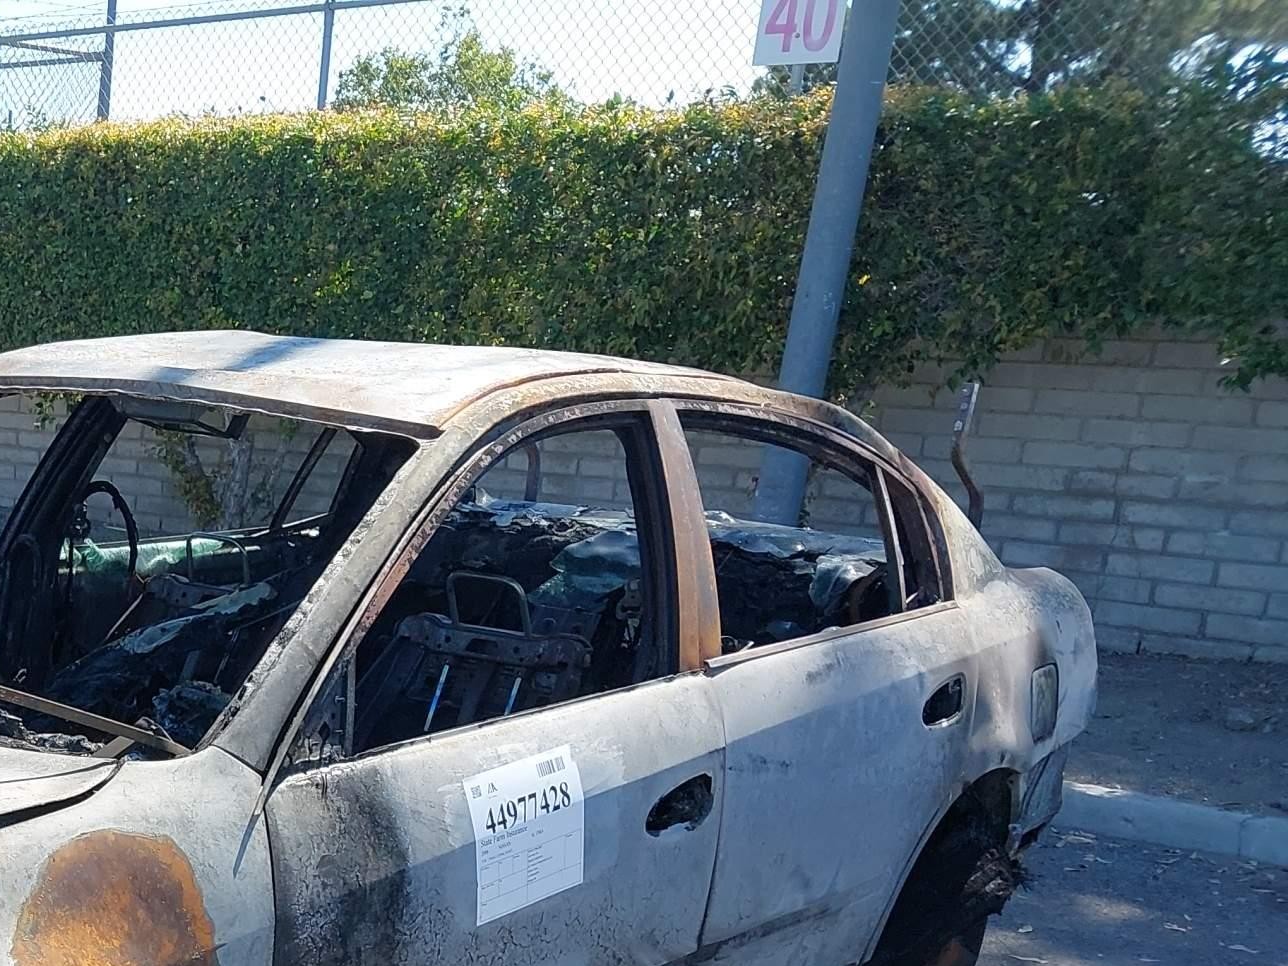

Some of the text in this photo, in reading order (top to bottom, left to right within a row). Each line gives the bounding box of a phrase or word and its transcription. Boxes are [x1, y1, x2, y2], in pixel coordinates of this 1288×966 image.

[765, 0, 838, 52] 40
[485, 781, 571, 834] 44977428
[480, 838, 493, 848] State
[493, 833, 506, 844] Farm
[506, 826, 528, 838] Insurance
